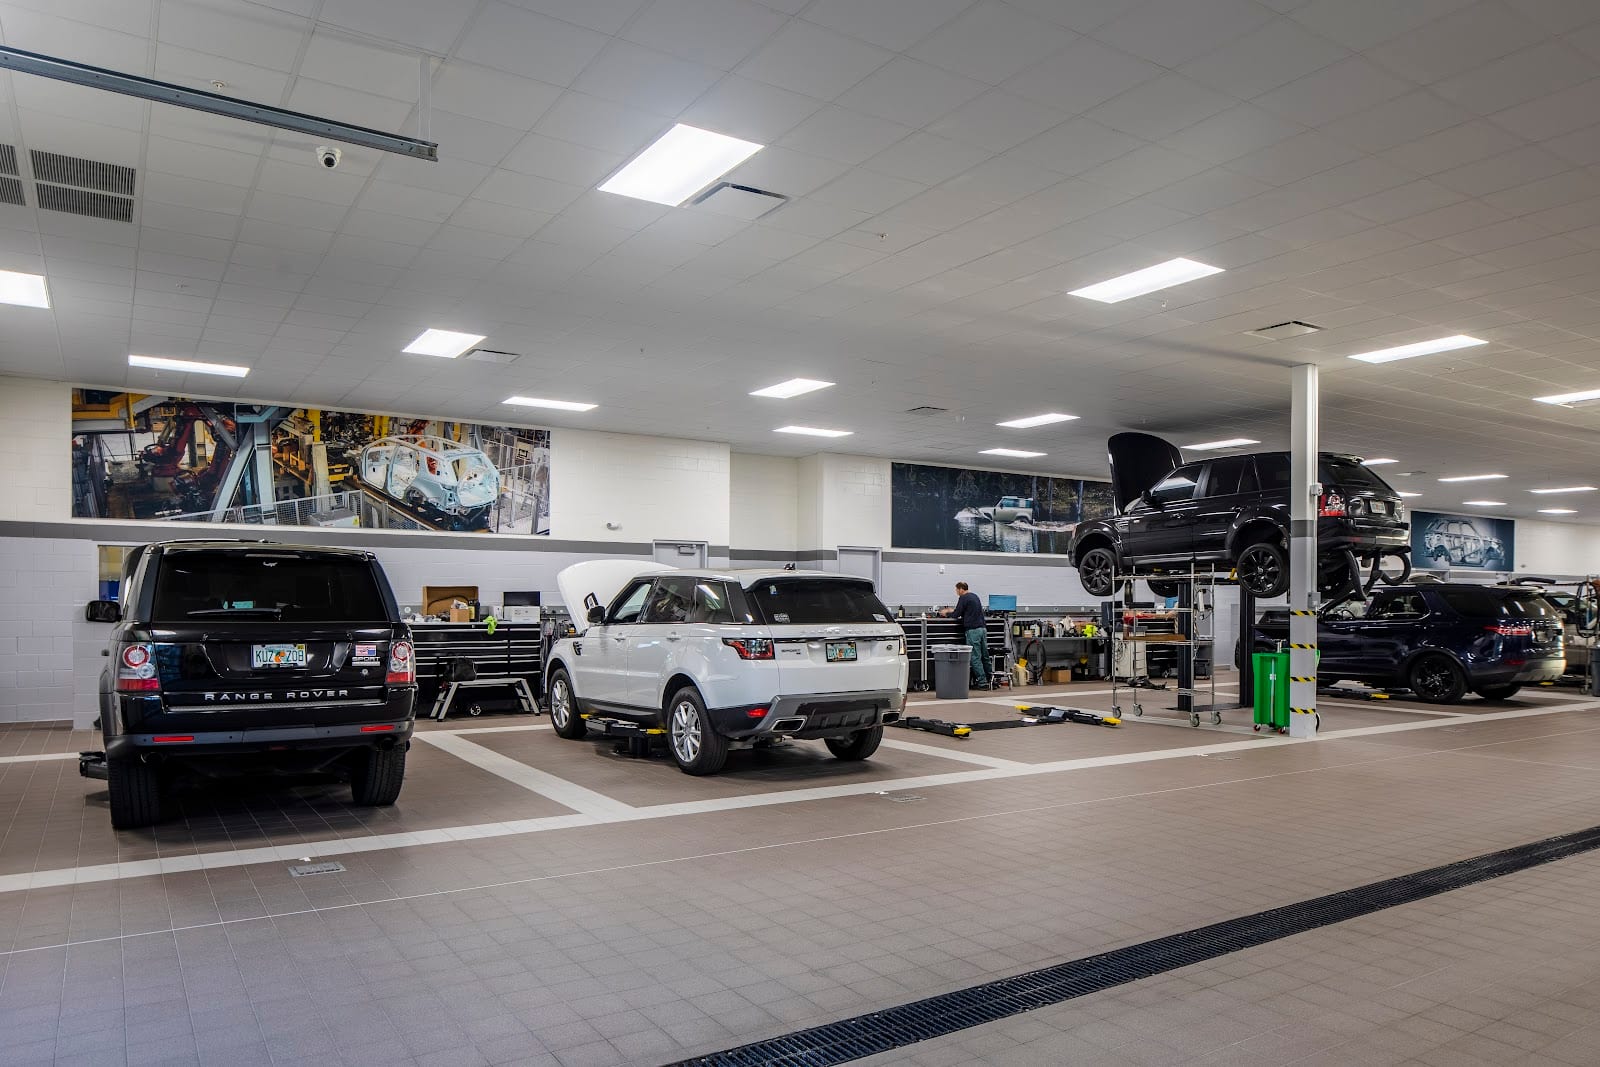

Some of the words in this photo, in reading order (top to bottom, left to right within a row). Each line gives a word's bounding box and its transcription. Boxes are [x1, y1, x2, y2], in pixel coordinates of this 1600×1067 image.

[256, 650, 274, 662] KUZ
[204, 693, 273, 701] RANGE
[286, 690, 348, 699] ROVER
